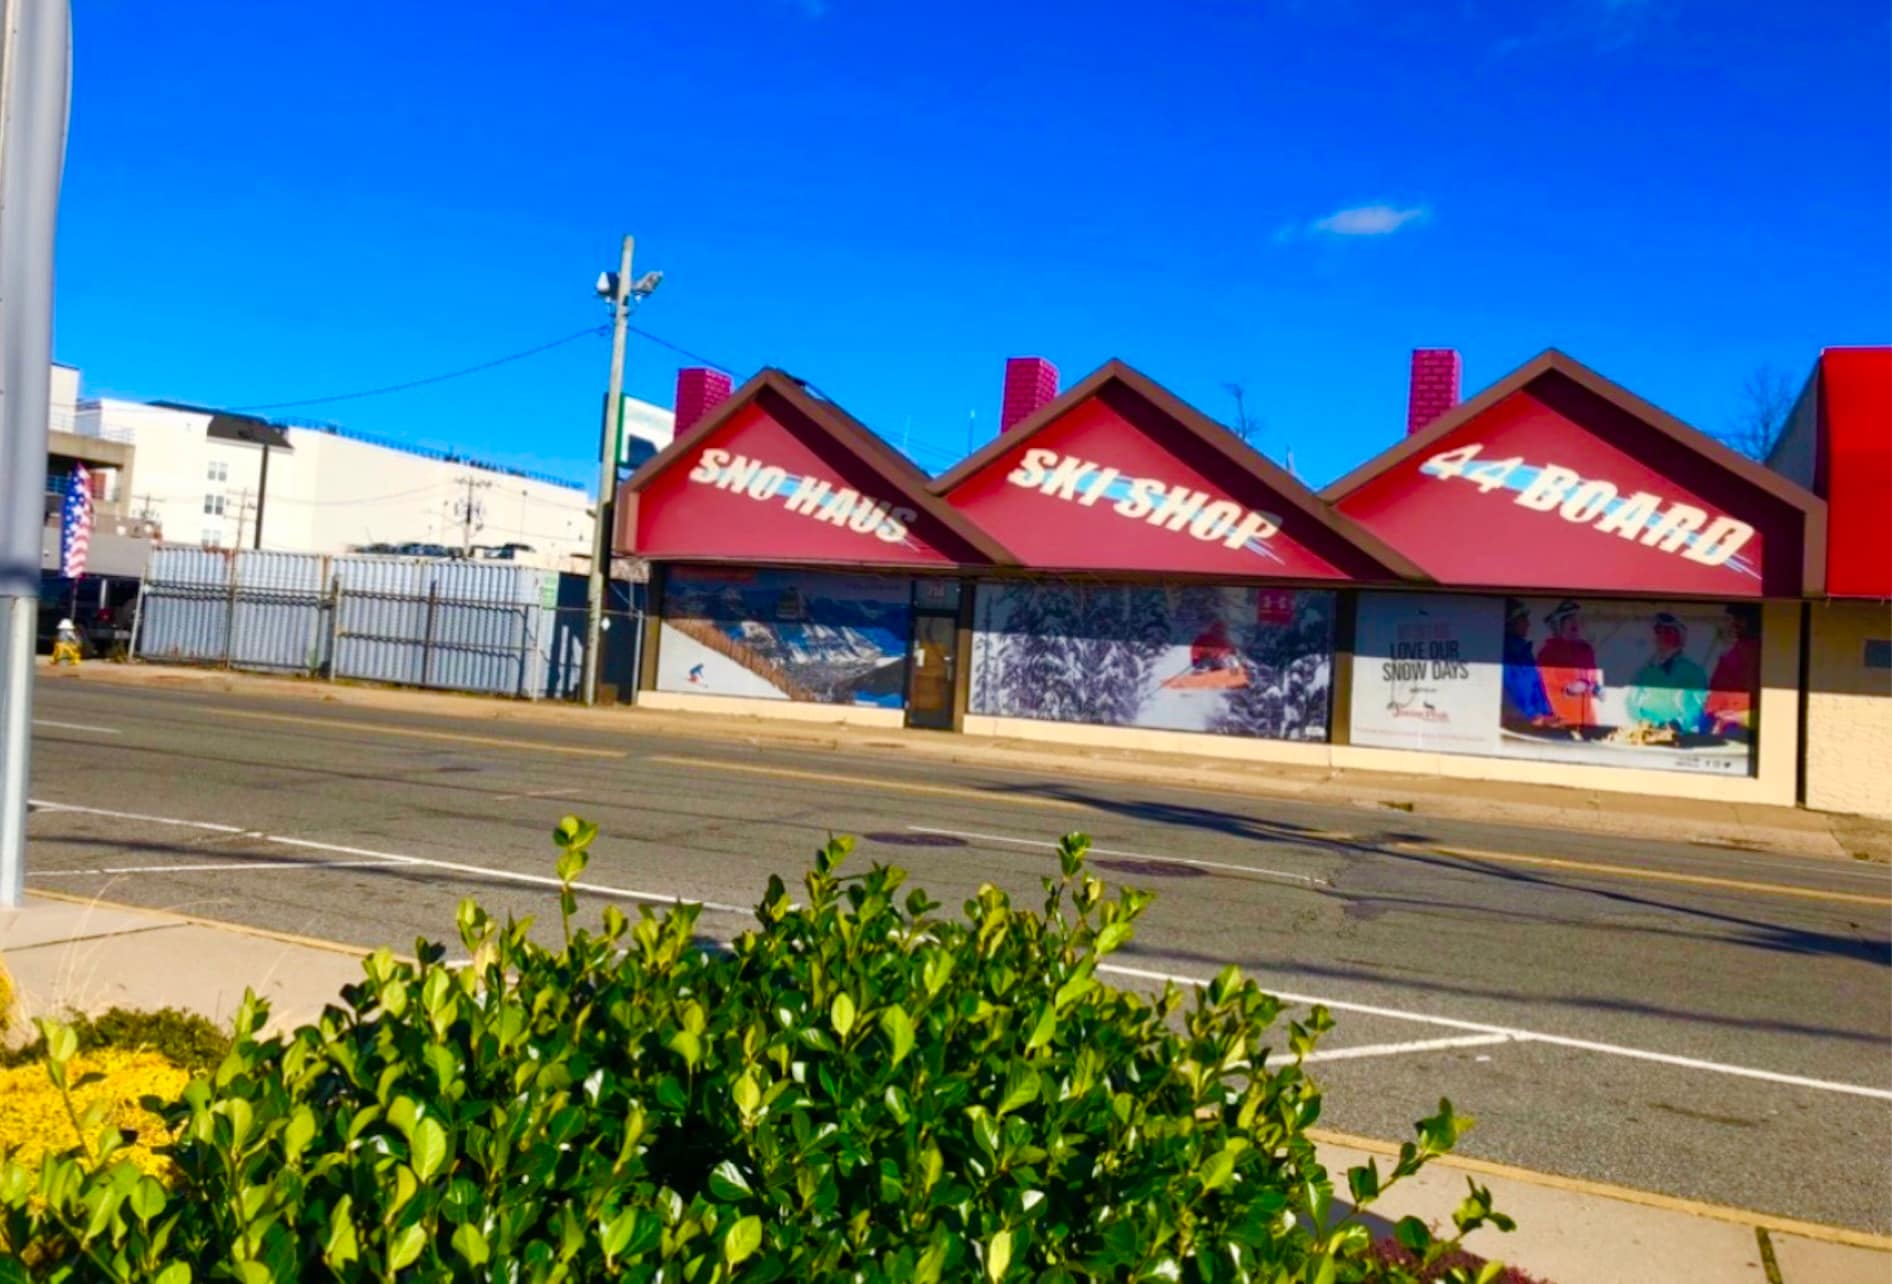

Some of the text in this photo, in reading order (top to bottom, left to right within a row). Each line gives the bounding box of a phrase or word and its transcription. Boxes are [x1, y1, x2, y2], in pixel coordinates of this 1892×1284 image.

[689, 447, 918, 543] SNO HAUS
[1007, 447, 1283, 550] SKI SHOP
[1513, 463, 1755, 566] BOARD
[1382, 660, 1470, 682] SNOW DAYS
[1389, 640, 1460, 661] LOVE OUR
